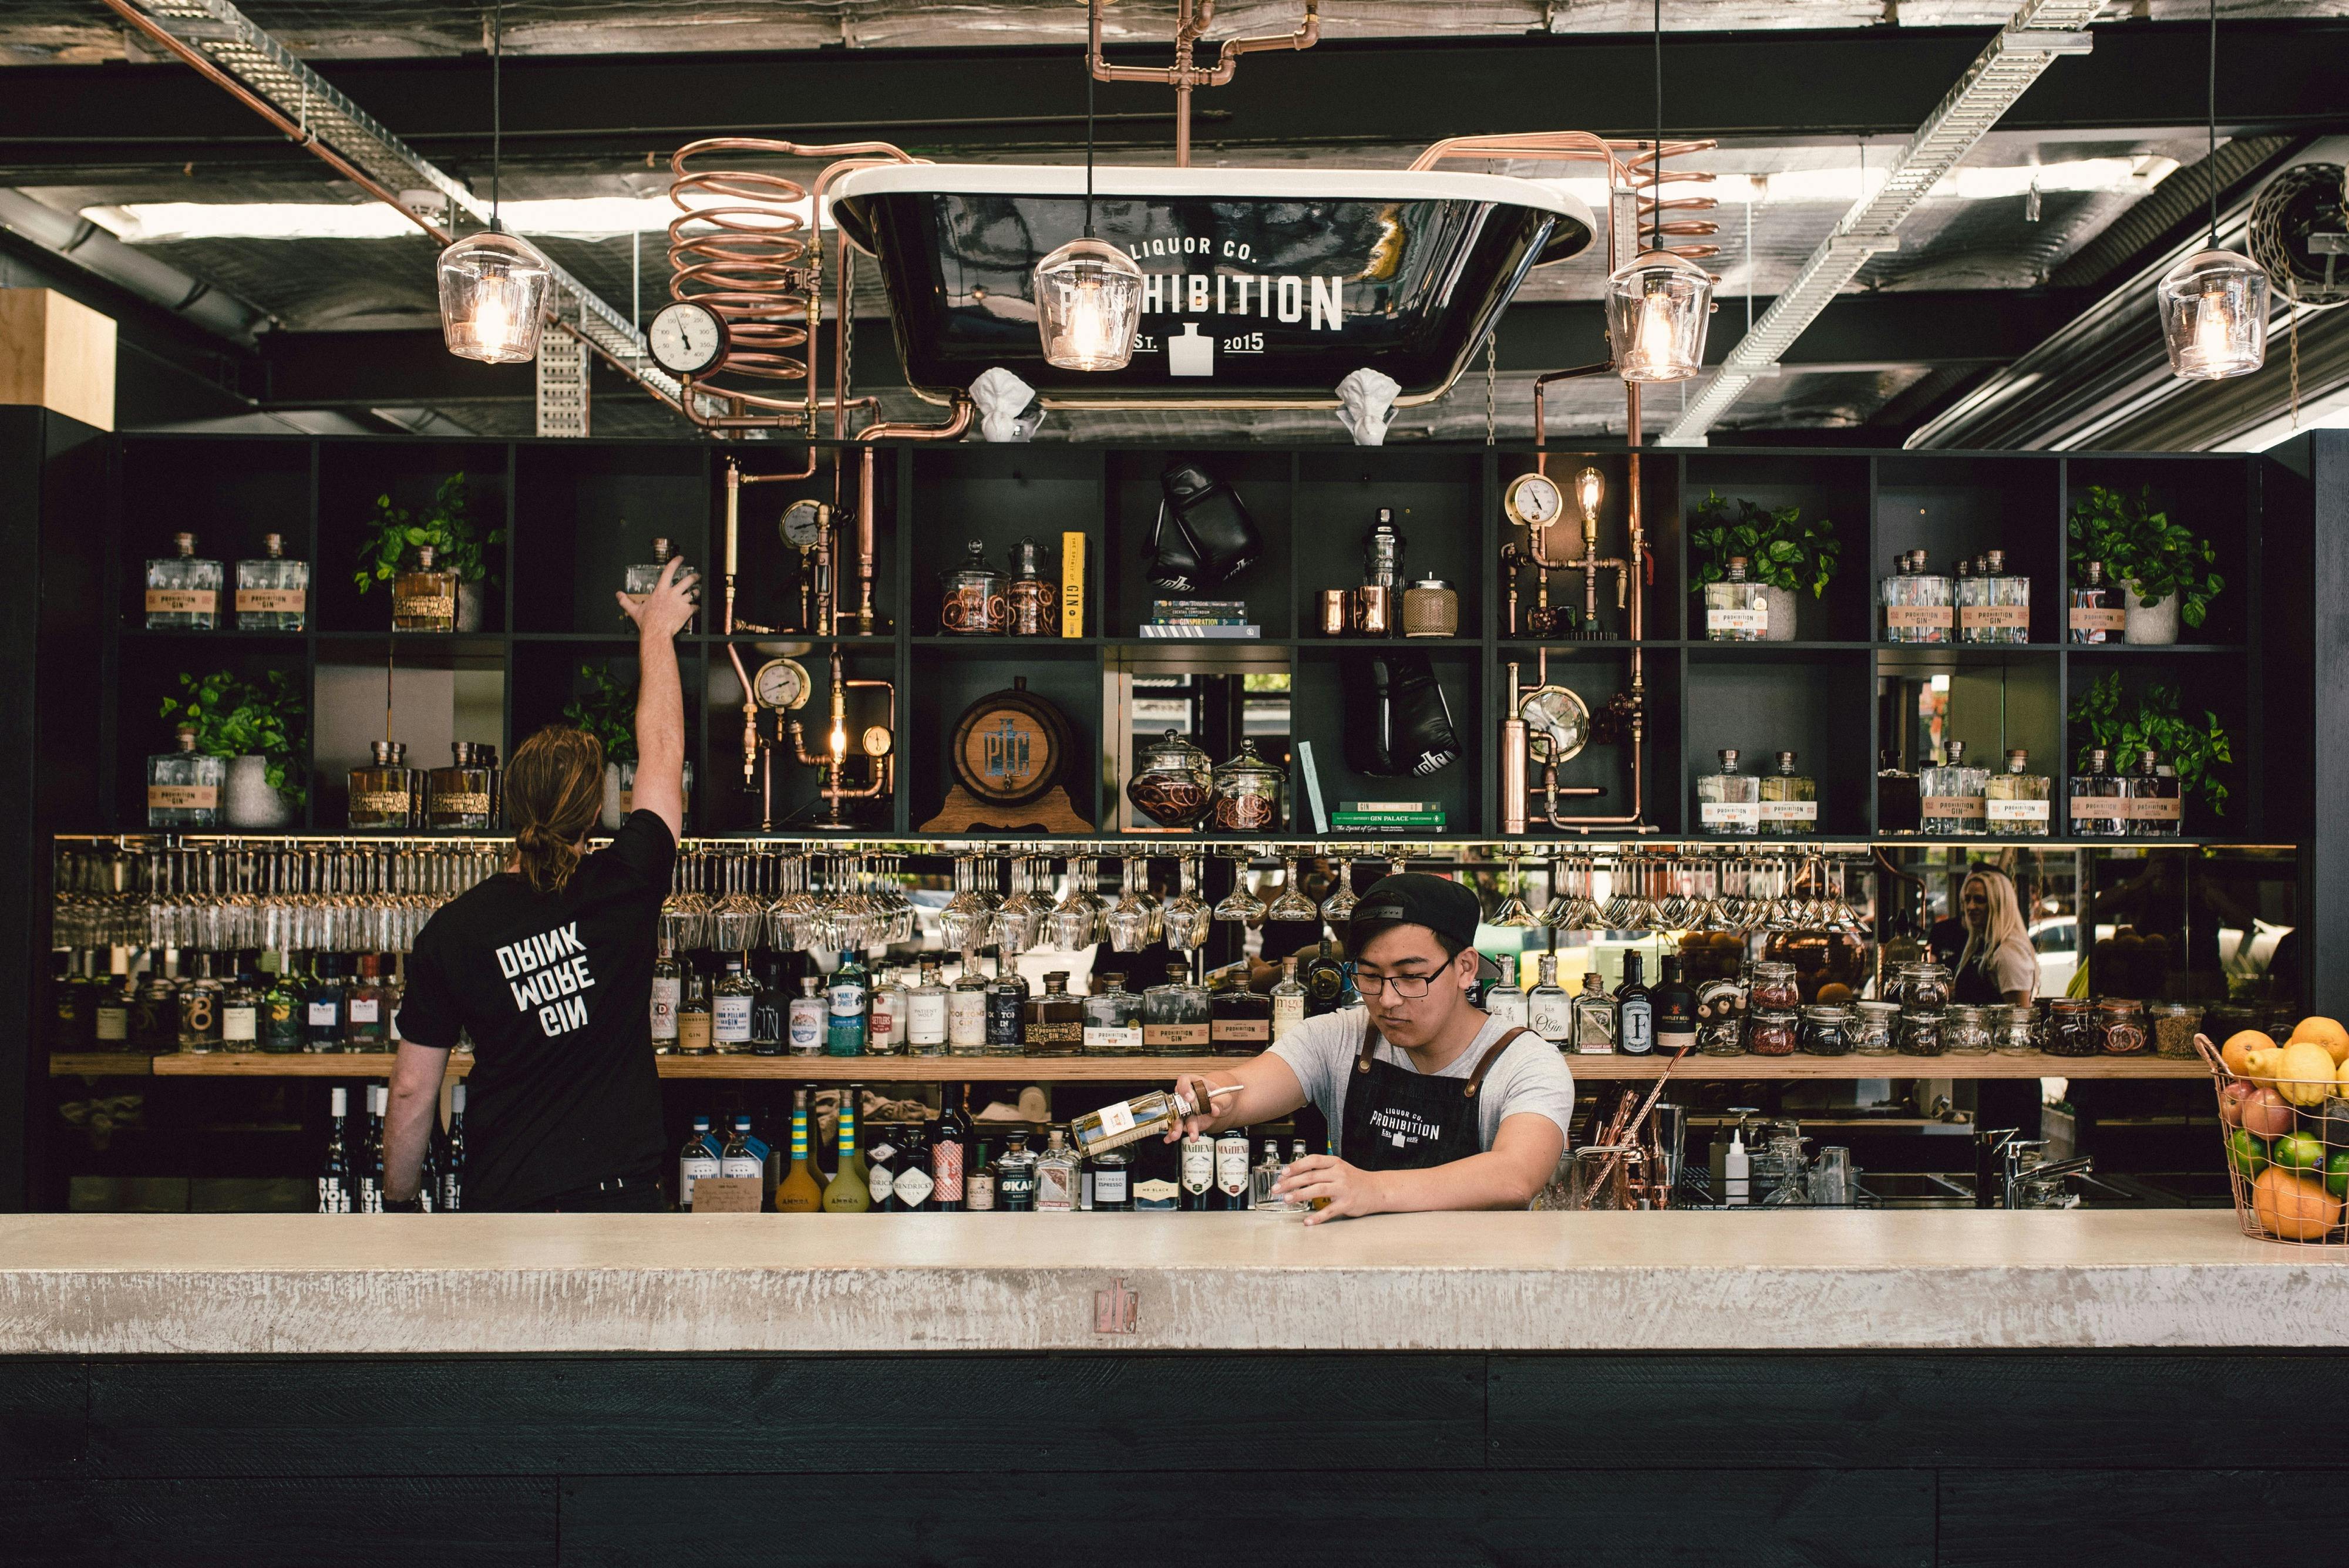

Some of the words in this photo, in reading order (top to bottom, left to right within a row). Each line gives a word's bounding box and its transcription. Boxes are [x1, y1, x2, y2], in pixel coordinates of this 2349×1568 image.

[1129, 236, 1211, 261] LIQUOR
[1223, 240, 1257, 264] CO.
[1133, 333, 1158, 352] ST.
[1224, 332, 1264, 352] 2015
[1066, 586, 1079, 606] GIN
[1277, 998, 1303, 1012] mgc
[1544, 1004, 1555, 1012] kis
[871, 1016, 891, 1025] SETTLERS
[1631, 1012, 1650, 1039] F
[1369, 1110, 1441, 1140] PROHIBITION
[1385, 1108, 1410, 1118] LIQUOR
[1412, 1113, 1423, 1122] CO.
